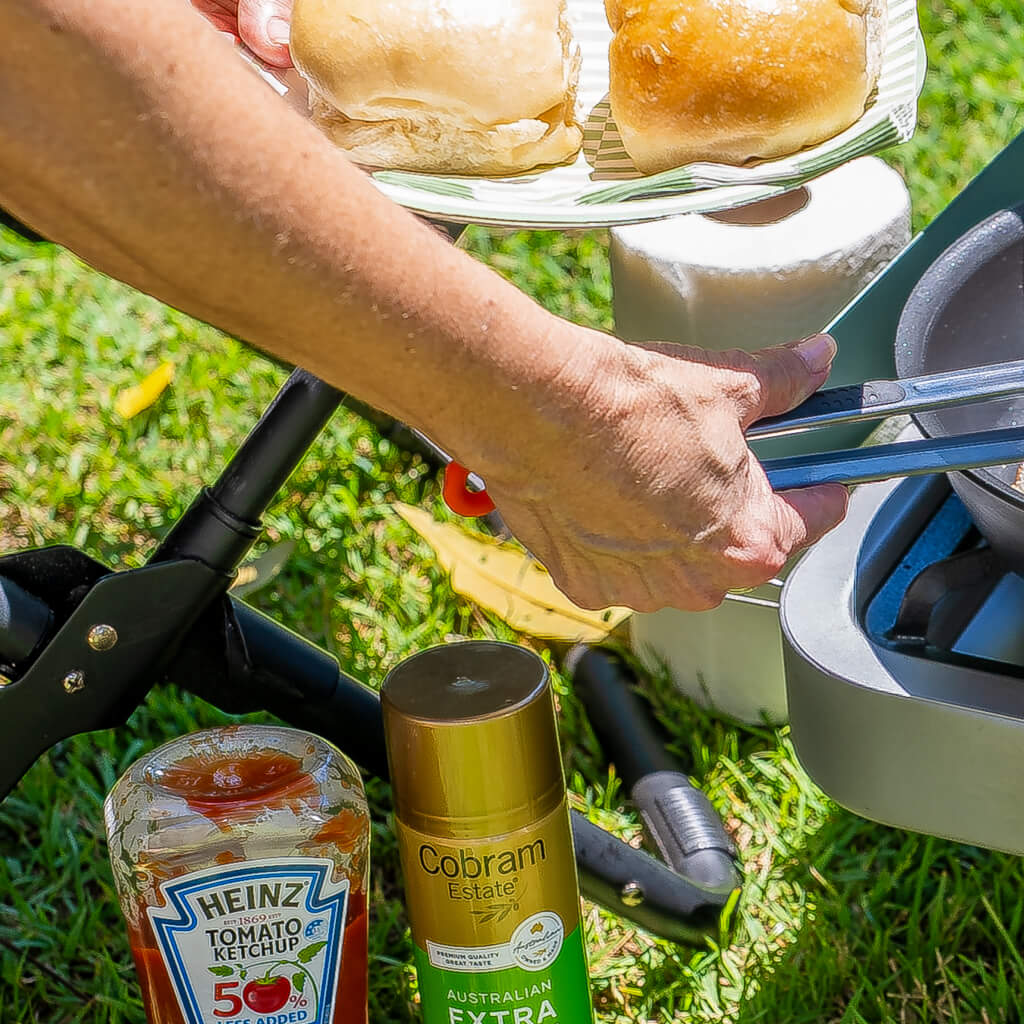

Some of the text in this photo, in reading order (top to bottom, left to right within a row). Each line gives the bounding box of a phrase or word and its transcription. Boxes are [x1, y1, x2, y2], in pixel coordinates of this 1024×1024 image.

[418, 838, 547, 879] Cobram
[196, 882, 304, 920] HEINZ
[447, 880, 516, 900] Estate
[239, 914, 267, 925] 1869
[205, 918, 302, 948] TOMATO
[213, 937, 300, 961] KETCHUP
[436, 950, 500, 960] PREMIUM QUALITY
[447, 979, 552, 1005] AUSTRALIAN
